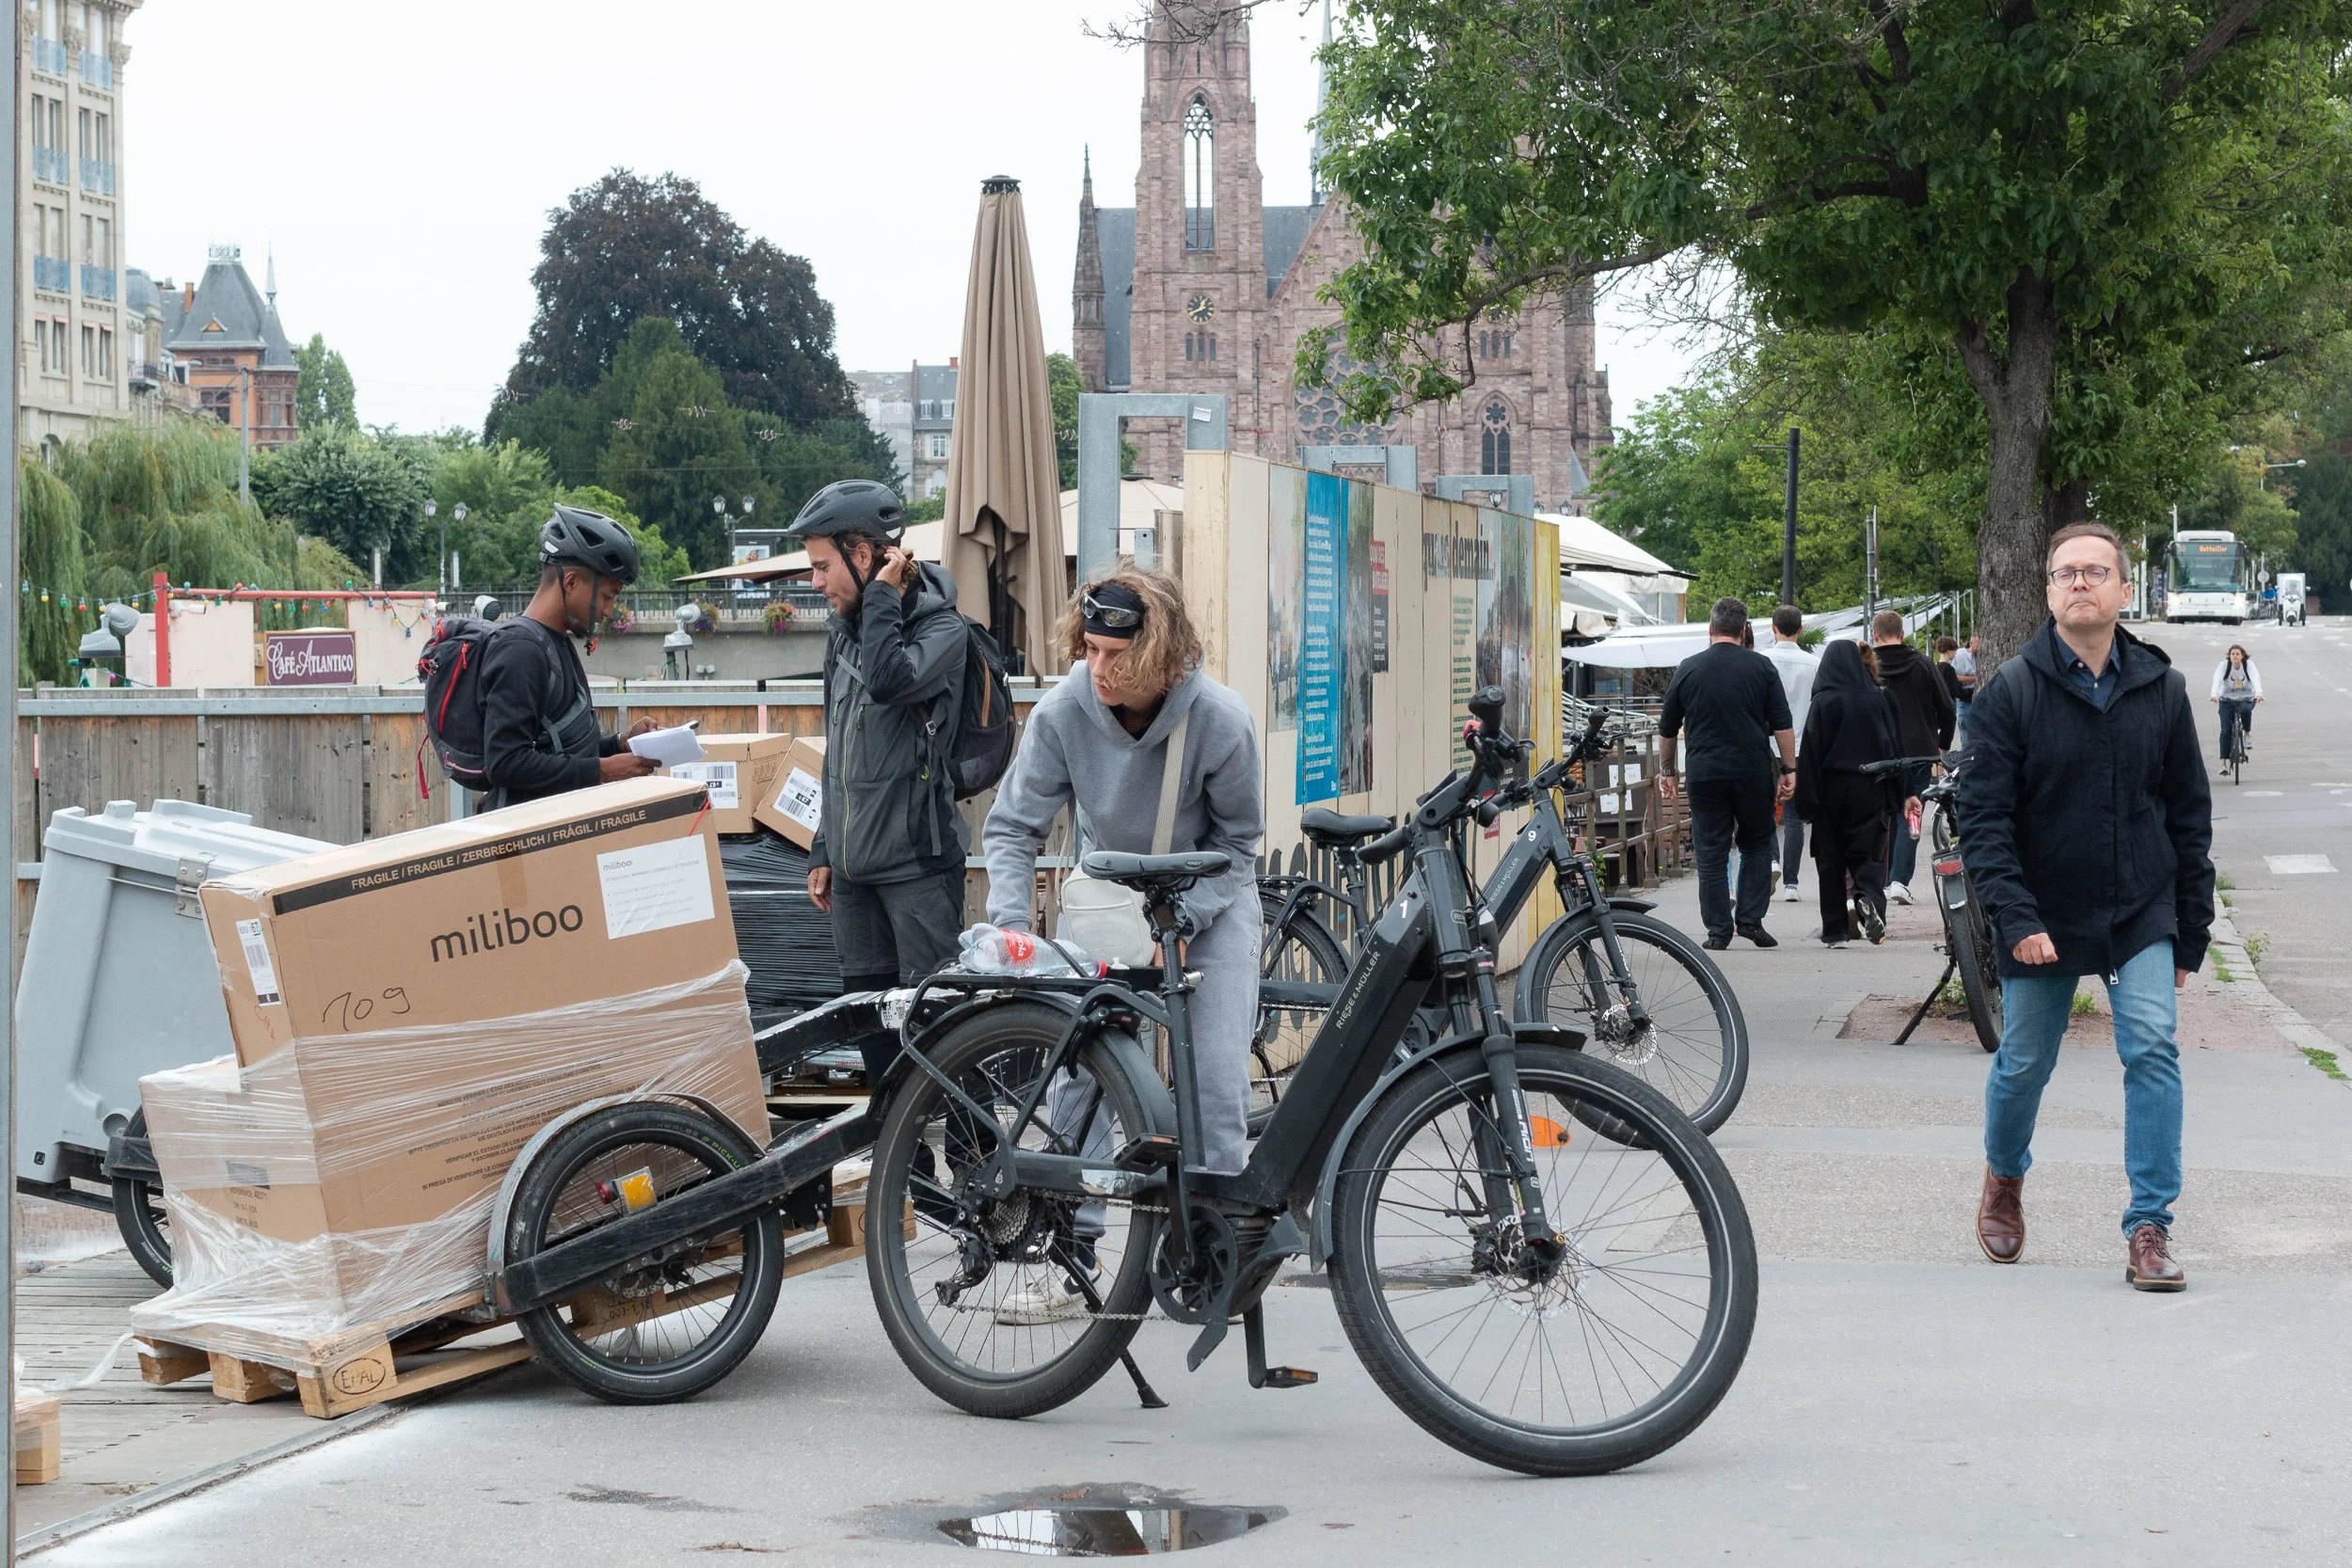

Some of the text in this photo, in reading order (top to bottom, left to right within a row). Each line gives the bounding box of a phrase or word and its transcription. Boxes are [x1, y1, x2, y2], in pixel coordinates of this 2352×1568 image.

[1528, 831, 1536, 842] 9
[352, 869, 399, 890] FRAGILE
[407, 856, 454, 877] FRAGILE
[462, 834, 545, 863] ZERBRECHLICH
[600, 810, 647, 830] FRAGILE
[603, 860, 632, 871] miliboo
[1400, 900, 1408, 919] 1
[430, 904, 583, 962] miliboo
[1336, 999, 1356, 1030] RIESE
[1356, 951, 1381, 993] MÜLLER
[322, 987, 410, 1032] 109
[533, 1079, 546, 1087] TOUT
[437, 1098, 454, 1107] MERCI
[454, 1096, 462, 1104] DE
[407, 1146, 423, 1155] BITTE
[516, 1114, 540, 1124] ARTIKELS
[486, 1129, 512, 1139] DEUTLICH
[512, 1119, 541, 1132] EVENTUELL
[445, 1152, 472, 1164] VERIFICAR
[481, 1144, 501, 1154] ESTADO
[476, 1151, 500, 1162] ESCRIBIR
[711, 1142, 741, 1168] PICK-U
[429, 1179, 447, 1188] PREGA
[453, 1167, 484, 1181] VERIFICARE
